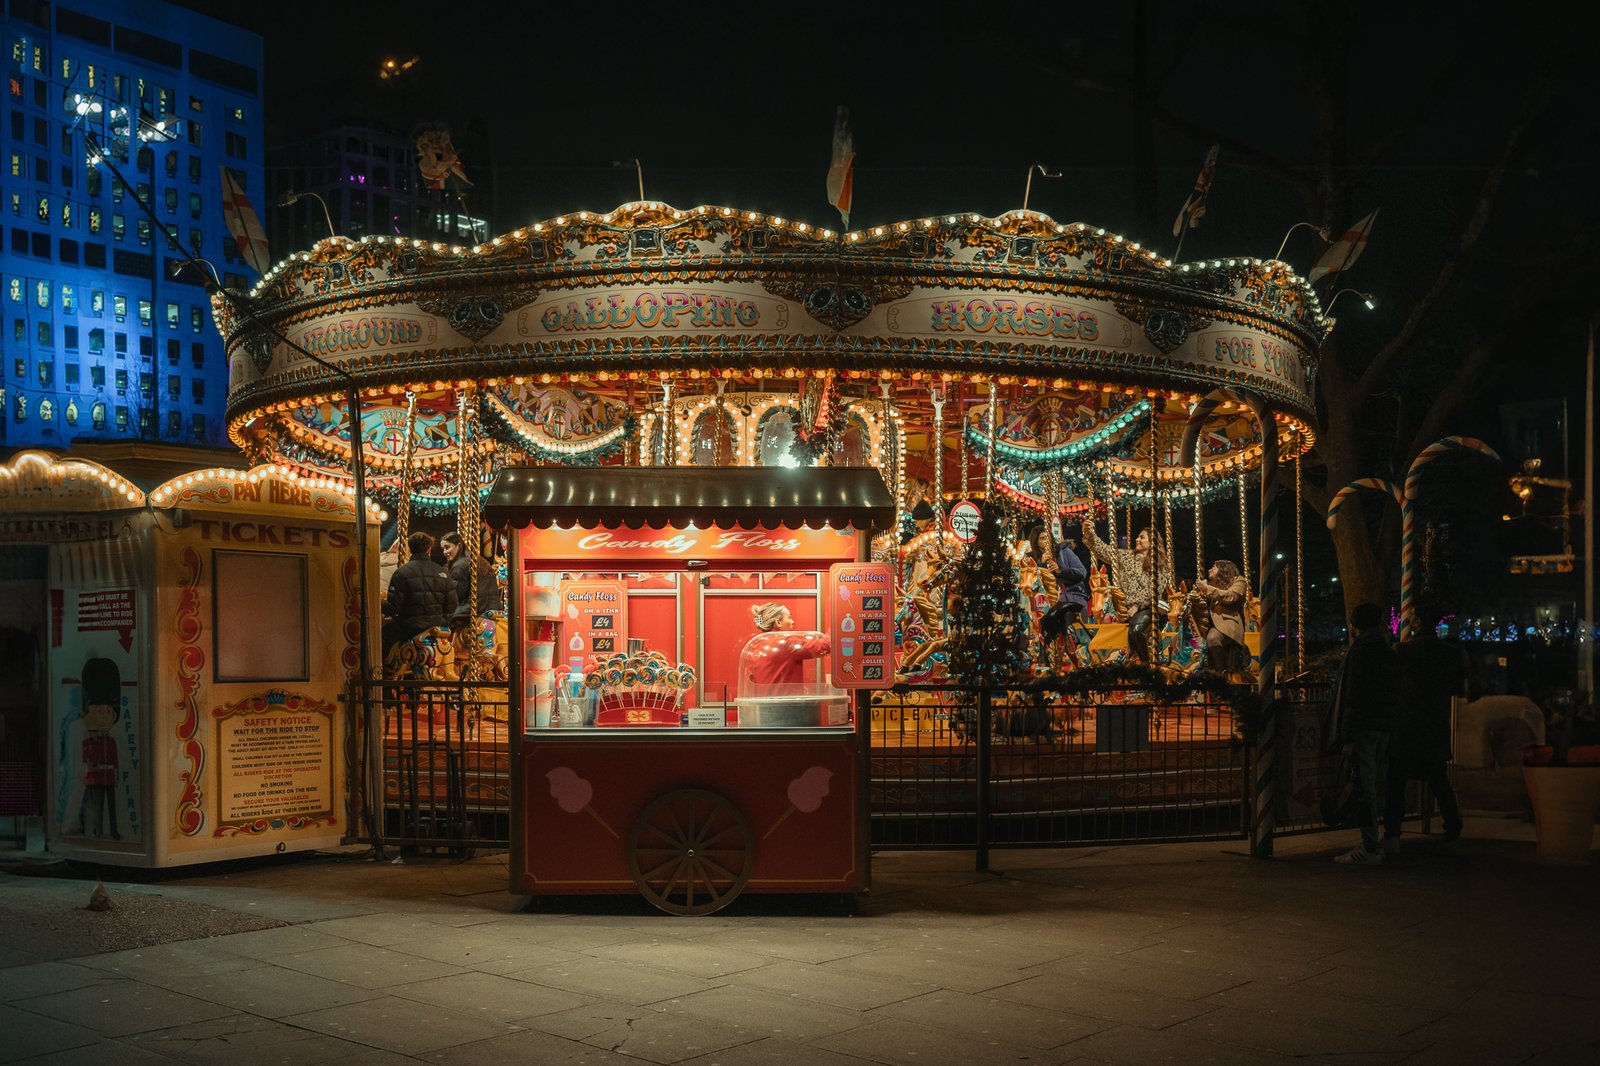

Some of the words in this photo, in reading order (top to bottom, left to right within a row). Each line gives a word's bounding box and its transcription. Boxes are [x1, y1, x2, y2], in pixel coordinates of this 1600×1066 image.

[542, 292, 761, 332] GALLOPING
[931, 299, 1100, 341] HORSES
[1216, 336, 1256, 368] FOR
[234, 480, 264, 502] PAY
[269, 480, 312, 507] HERE
[192, 520, 350, 549] TICKETS
[577, 532, 698, 554] Candy
[710, 531, 801, 550] Floss
[840, 572, 863, 584] Candy
[865, 572, 886, 583] Floss
[568, 591, 593, 602] Candy
[595, 591, 618, 602] Floss
[865, 598, 880, 609] £4
[594, 617, 609, 628] £4
[865, 621, 880, 632] £4
[595, 639, 611, 649] £4
[865, 643, 880, 654] £6
[864, 667, 881, 678] £3
[244, 717, 277, 727] SAFETY
[280, 716, 312, 724] NOTICE
[627, 710, 650, 722] £3
[121, 696, 138, 770] SAFETY
[122, 772, 139, 834] FIRST
